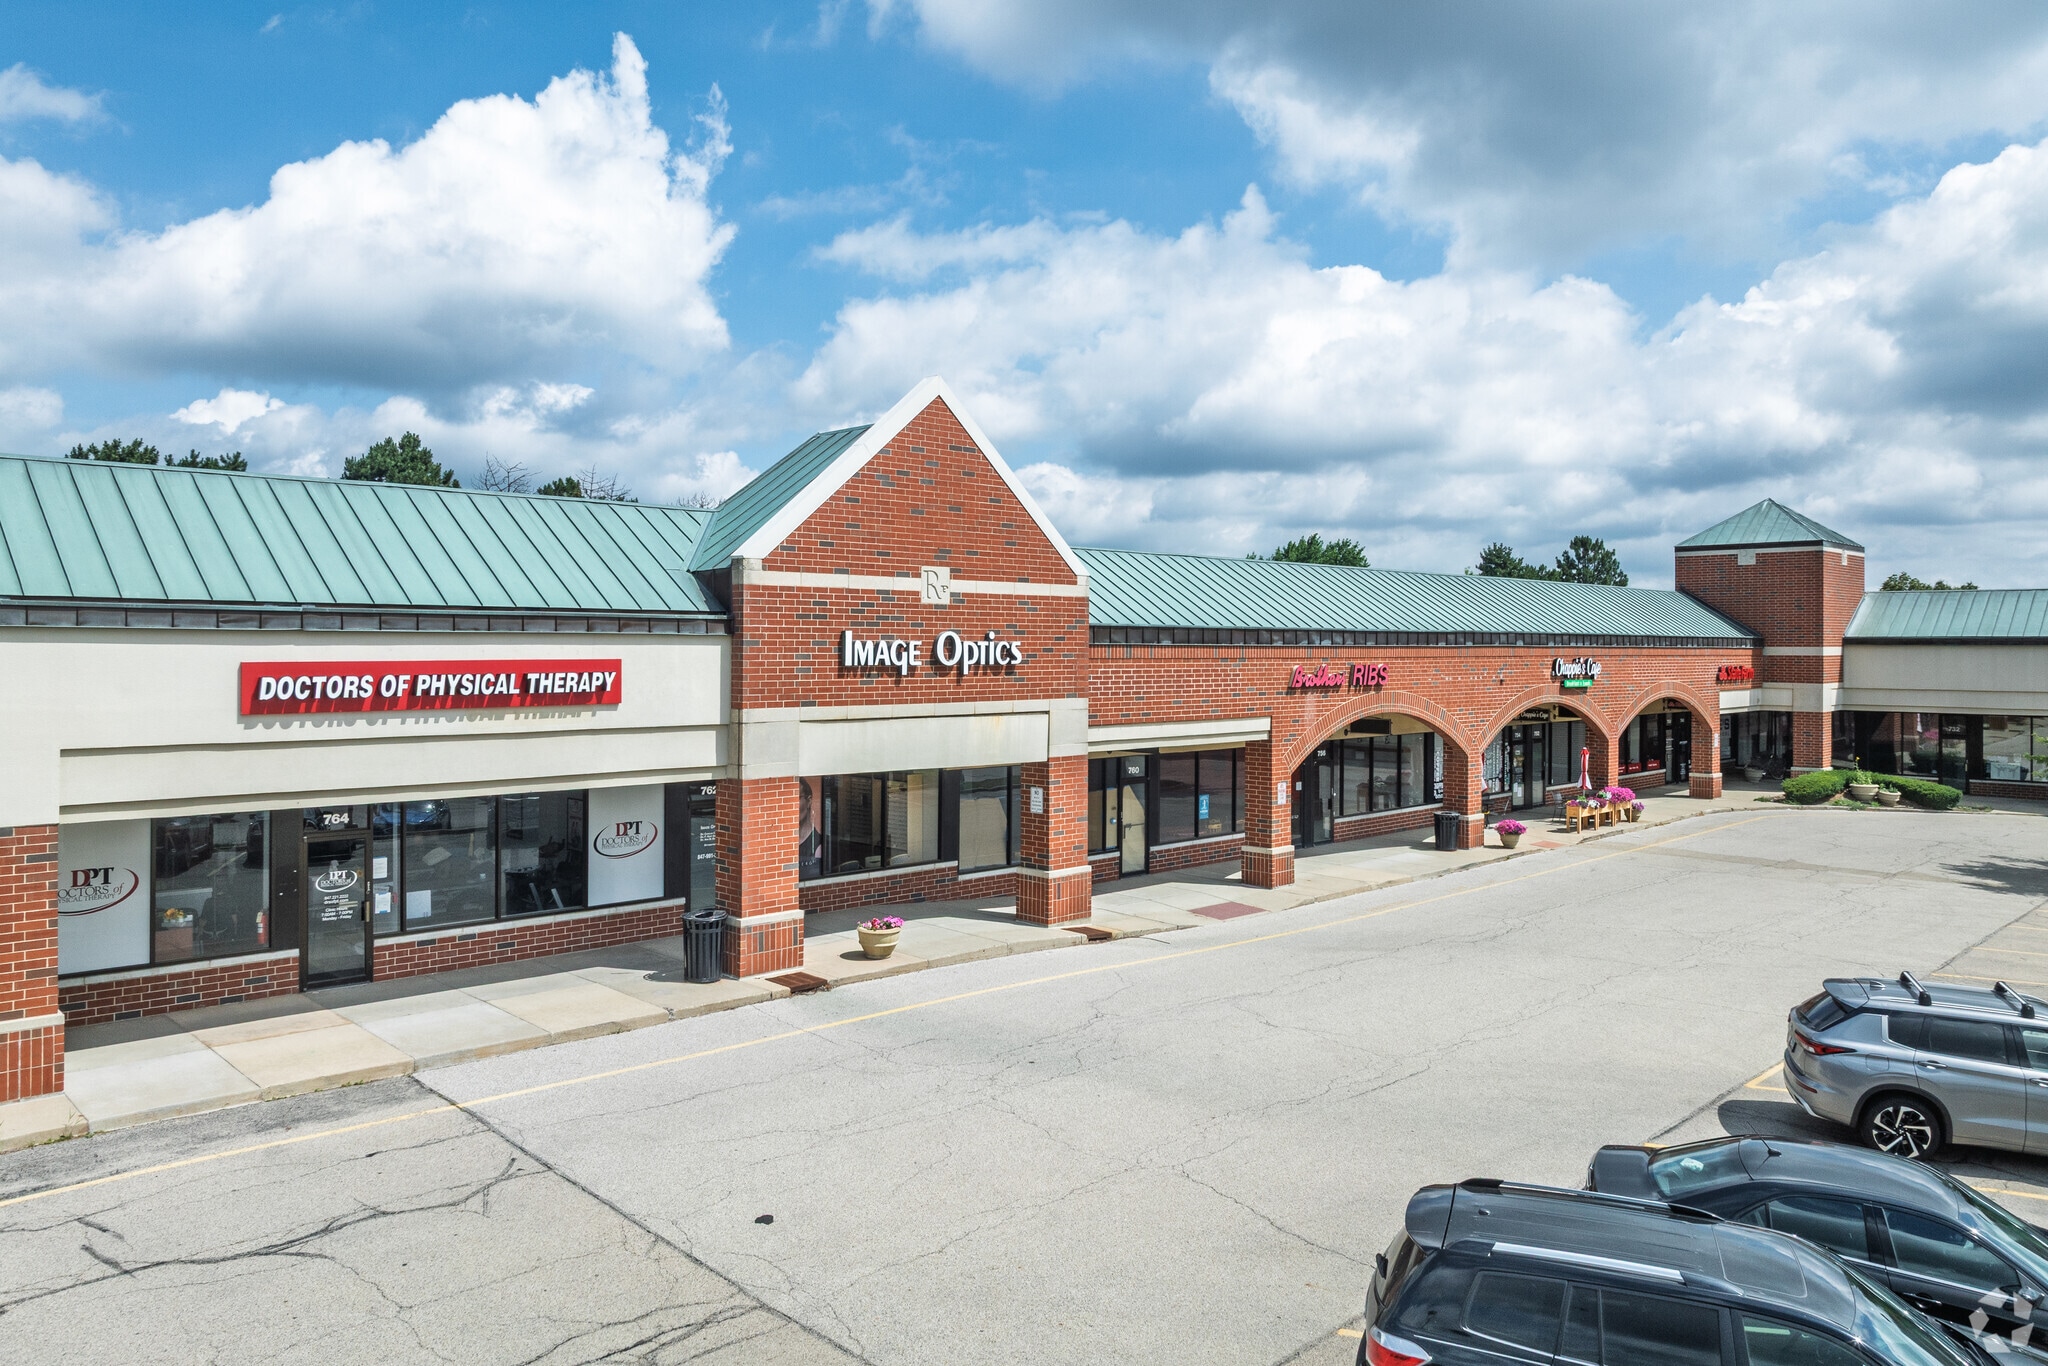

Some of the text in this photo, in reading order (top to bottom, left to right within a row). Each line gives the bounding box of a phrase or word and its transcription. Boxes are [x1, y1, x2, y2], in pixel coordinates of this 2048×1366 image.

[1353, 664, 1389, 686] RIBS
[259, 671, 617, 701] DOCTORS OF PHYSICAL THERAPY
[323, 813, 350, 825] 764
[615, 820, 643, 837] DPT
[602, 832, 649, 846] DOCTORS of
[71, 867, 115, 888] DPT
[58, 882, 125, 898] OCTORS of
[85, 893, 116, 901] THERAPY
